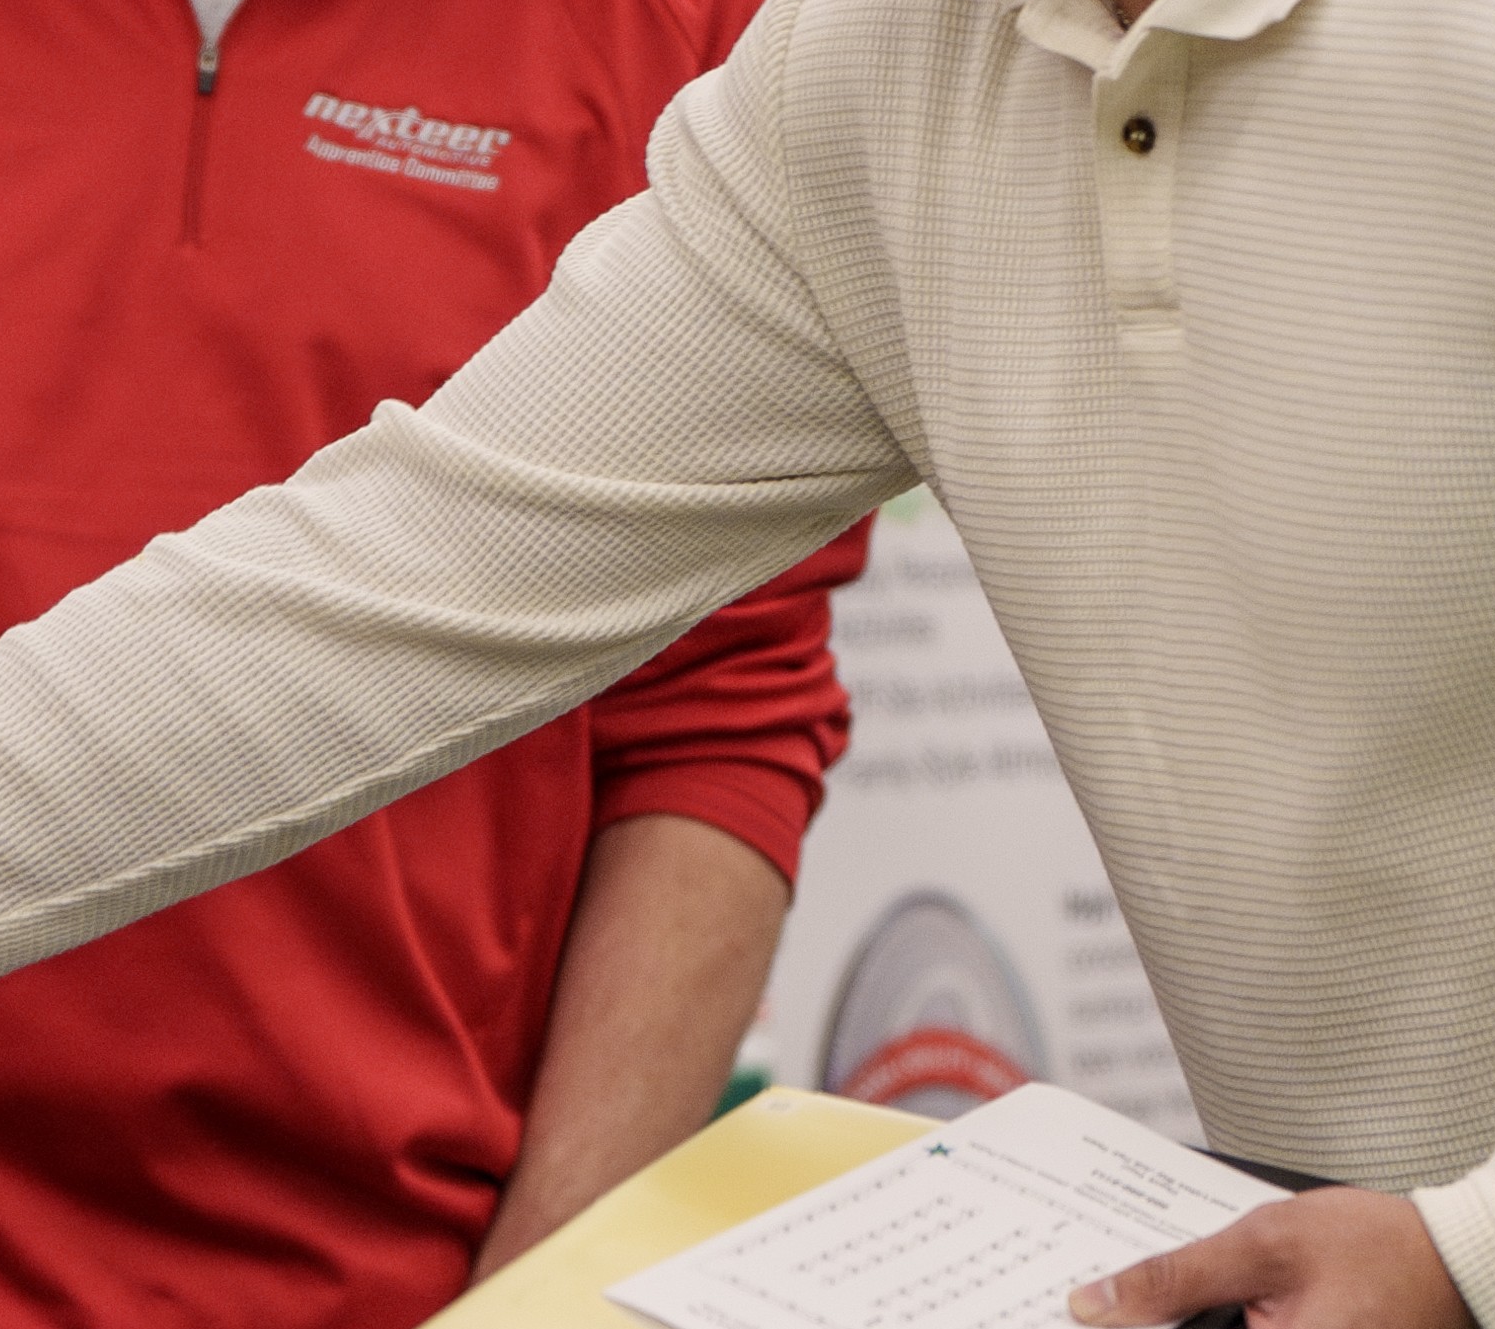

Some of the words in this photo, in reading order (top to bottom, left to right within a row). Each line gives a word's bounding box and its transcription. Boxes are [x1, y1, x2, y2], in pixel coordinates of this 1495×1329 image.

[302, 92, 512, 155] nexteer
[305, 133, 401, 174] Apprentice
[403, 156, 499, 192] Committee
